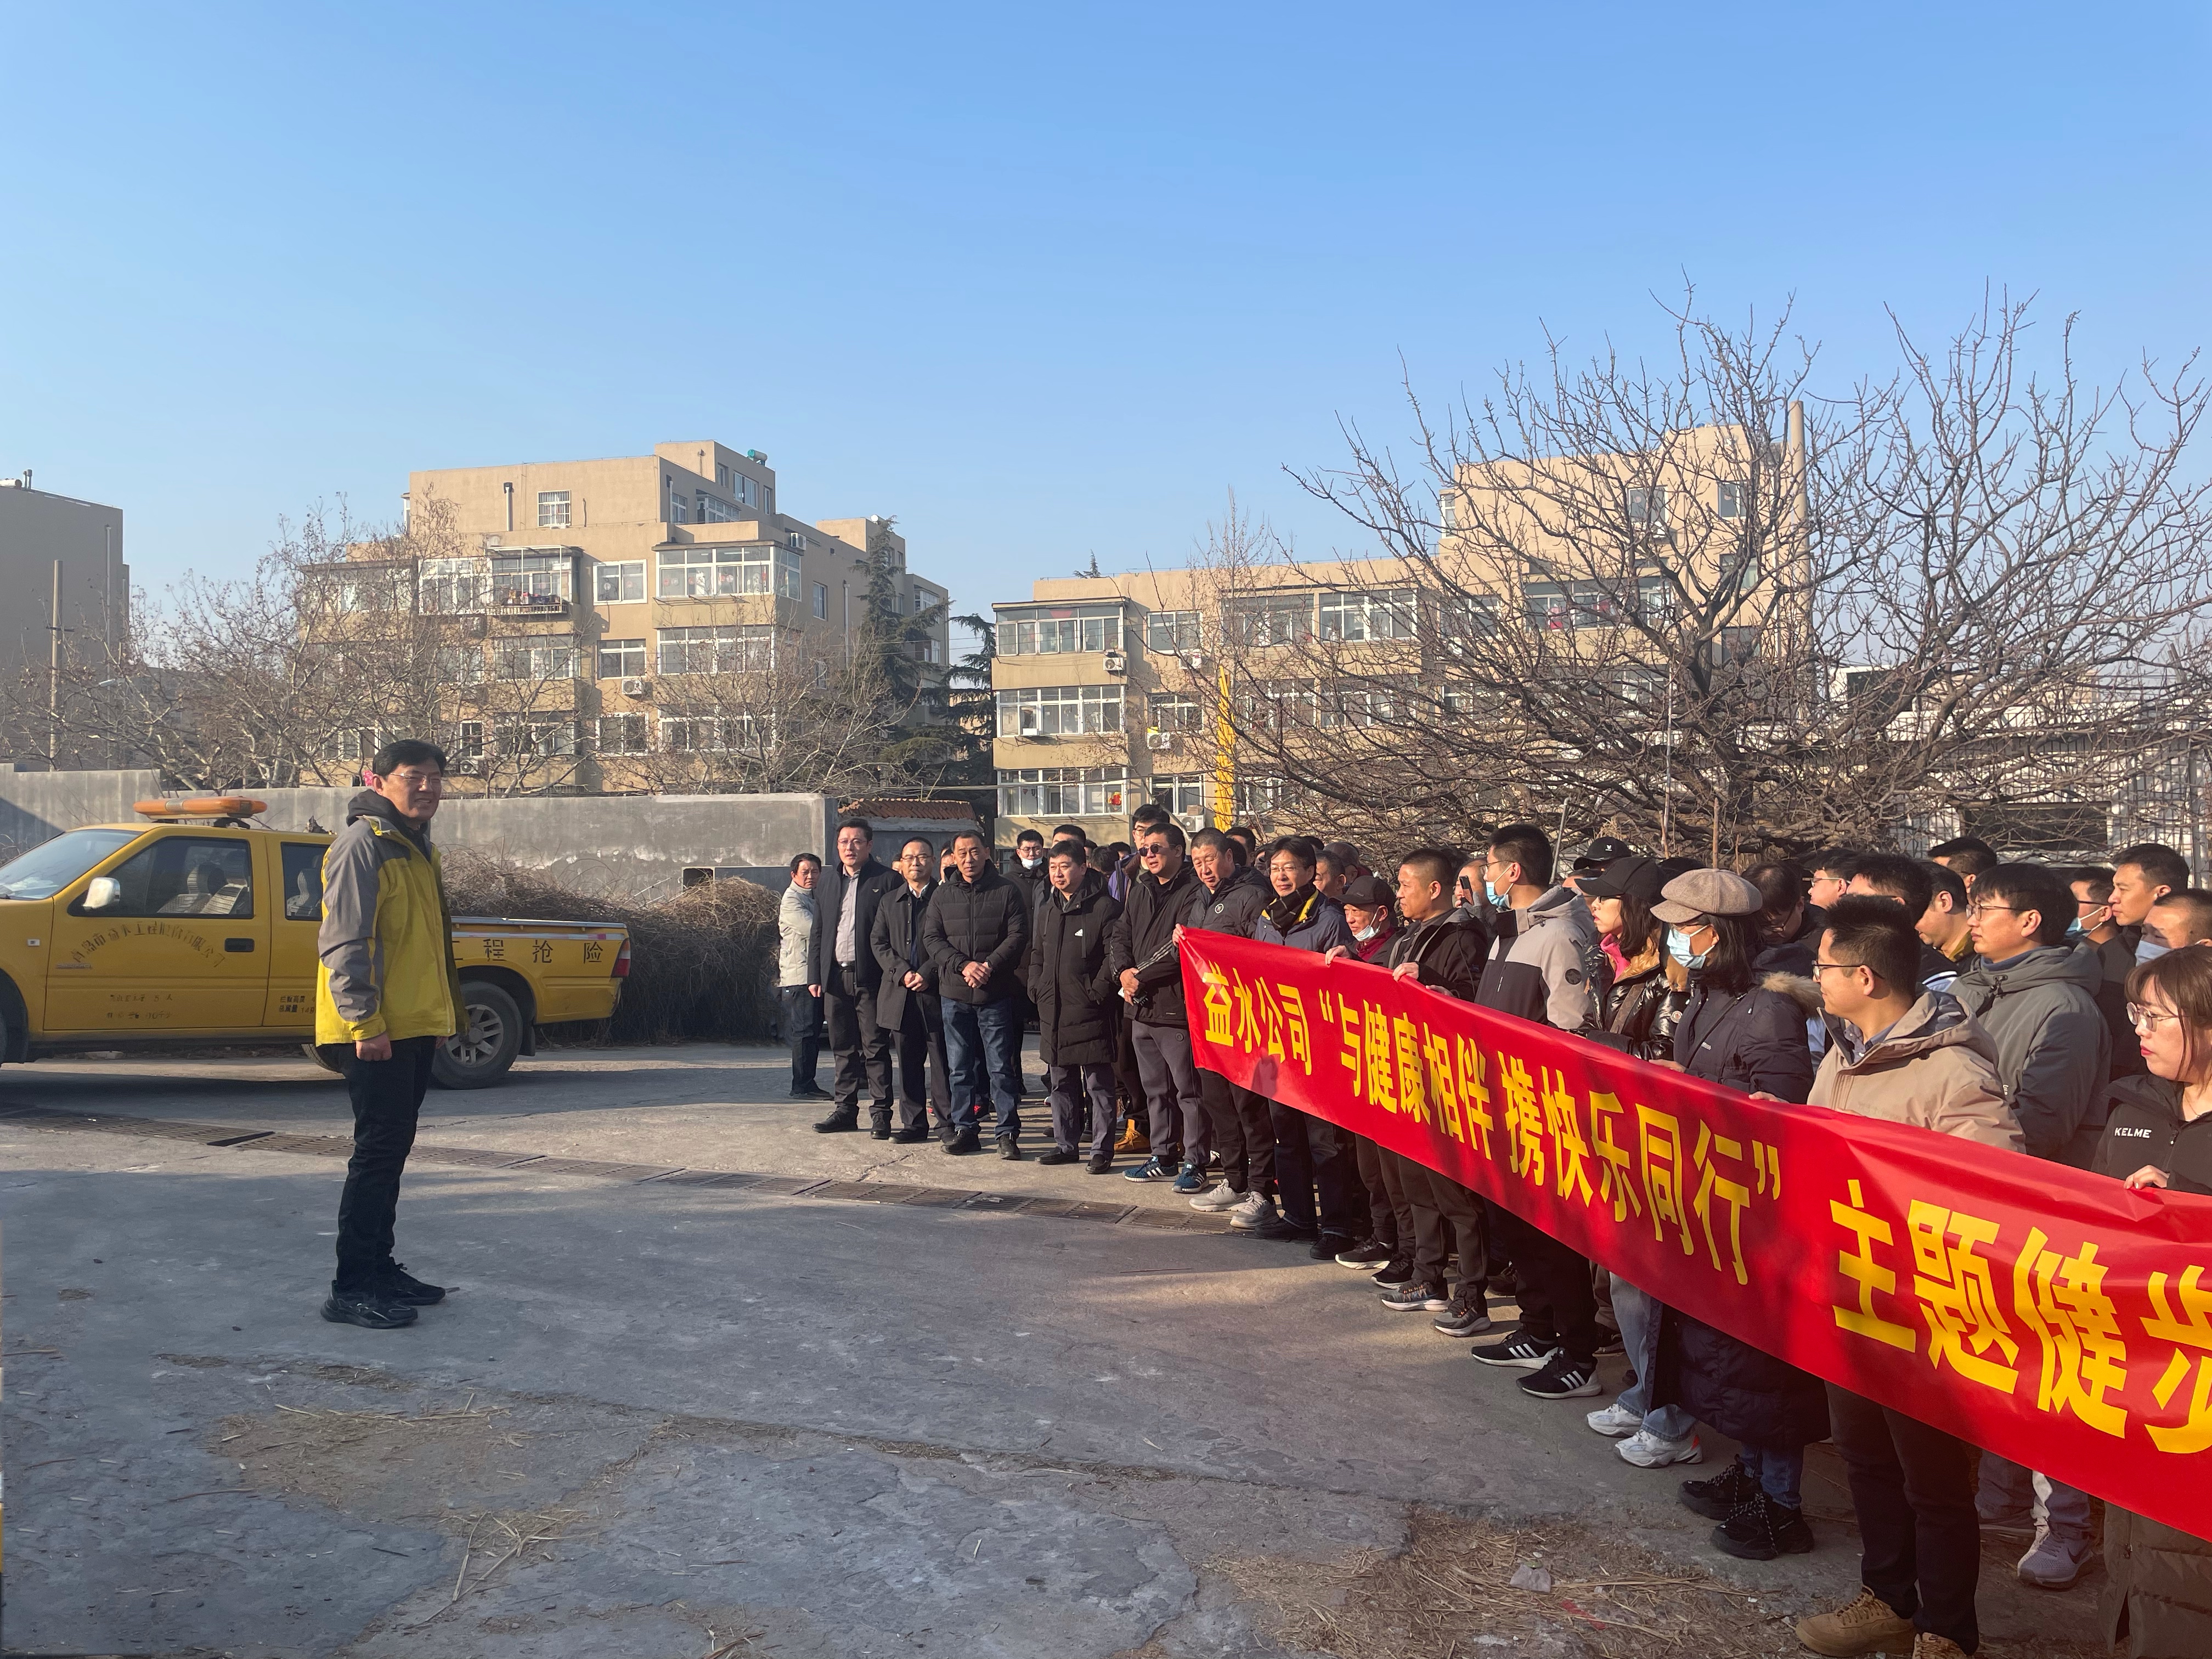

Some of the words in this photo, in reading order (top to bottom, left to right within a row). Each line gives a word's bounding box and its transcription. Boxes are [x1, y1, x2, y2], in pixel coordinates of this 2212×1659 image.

[1203, 961, 1312, 1075] 益水公司
[2114, 1127, 2152, 1138] KELME
